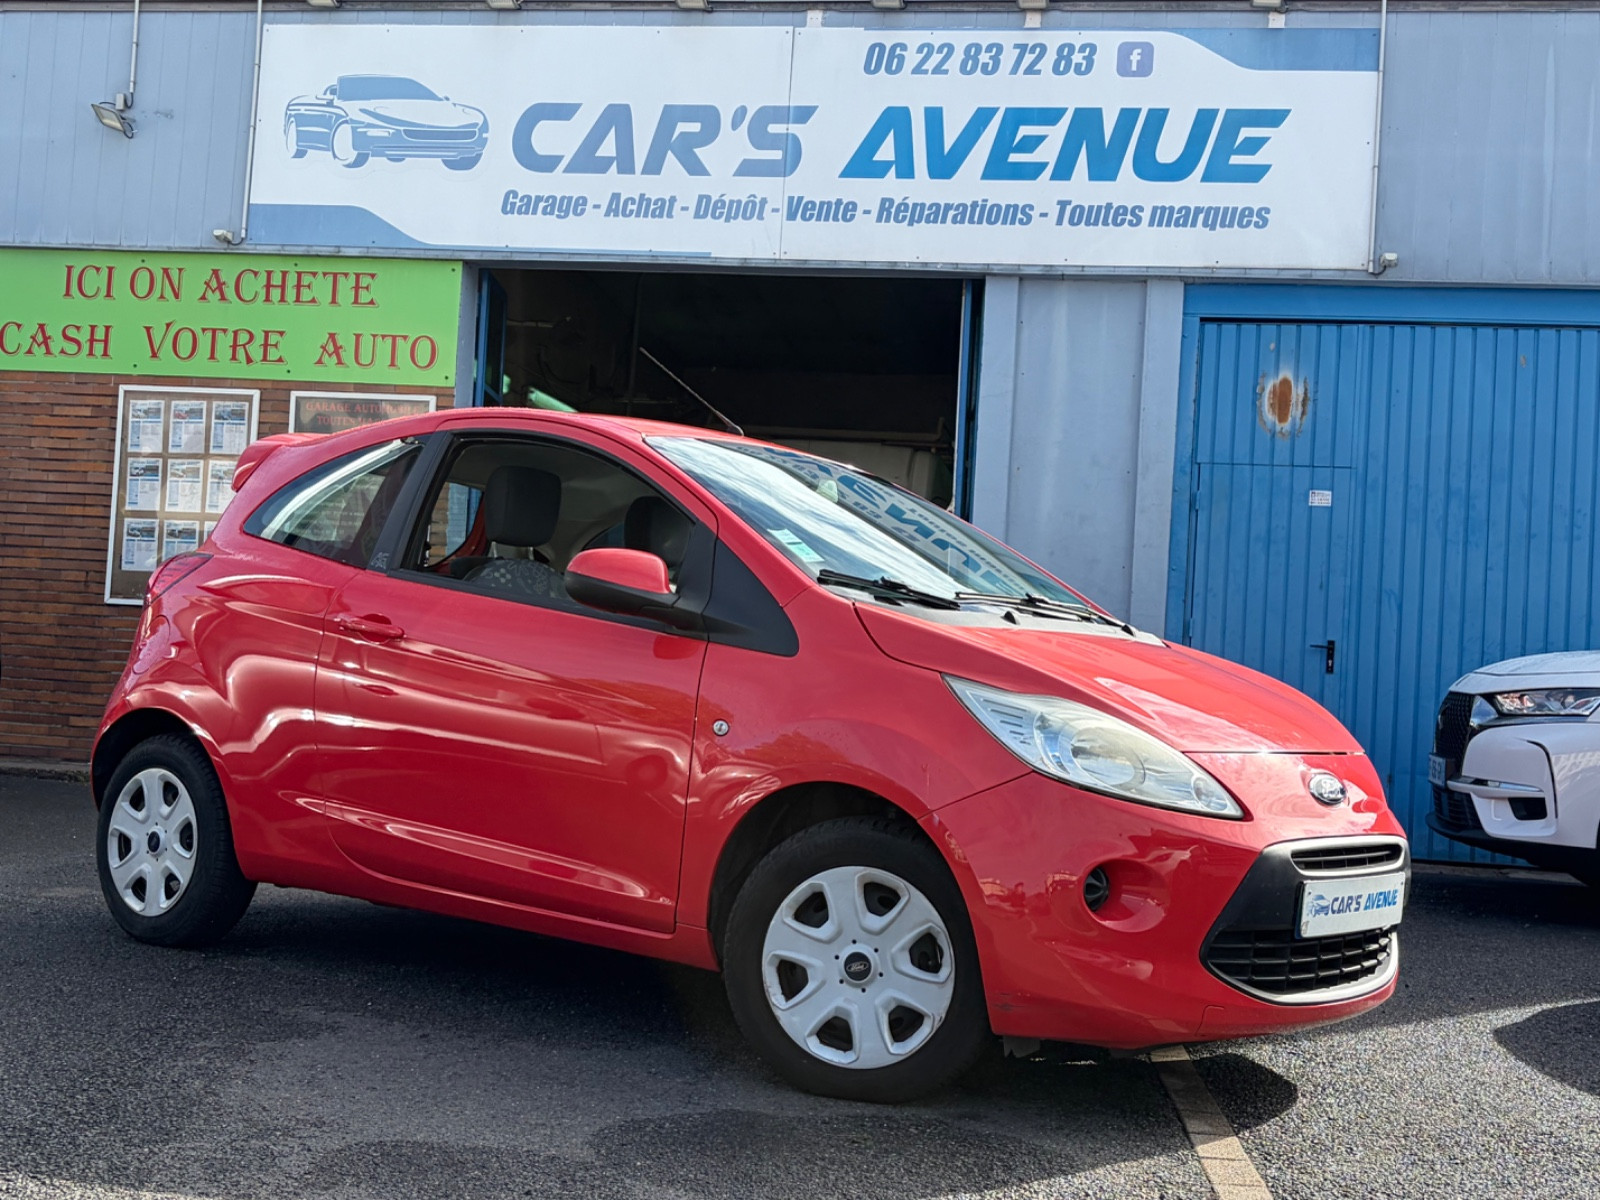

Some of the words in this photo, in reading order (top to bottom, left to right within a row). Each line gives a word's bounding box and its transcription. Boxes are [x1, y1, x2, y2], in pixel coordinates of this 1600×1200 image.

[863, 42, 907, 75] 06
[911, 42, 956, 75] 22
[959, 42, 1004, 76] 83
[1009, 42, 1048, 76] 72
[1051, 42, 1098, 76] 83
[511, 102, 819, 178] CAR'S
[838, 105, 1292, 183] AVENUE
[500, 189, 588, 219] Garage
[604, 192, 678, 220] Achat
[693, 193, 769, 223] Dépôt
[785, 196, 857, 222] Vente
[875, 196, 1034, 227] Réparations
[1055, 200, 1144, 229] Toutes
[1147, 203, 1271, 232] marques
[63, 265, 115, 300] ICI
[129, 266, 186, 301] ON
[198, 268, 380, 307] ACHETE
[0, 321, 113, 359] CASH
[143, 320, 289, 366] VOTRE
[314, 332, 439, 370] AUTO
[305, 402, 351, 413] GARAGE
[317, 415, 356, 426] TOUTES
[1331, 894, 1363, 915] CAR'S
[1363, 889, 1398, 911] AVENUE
